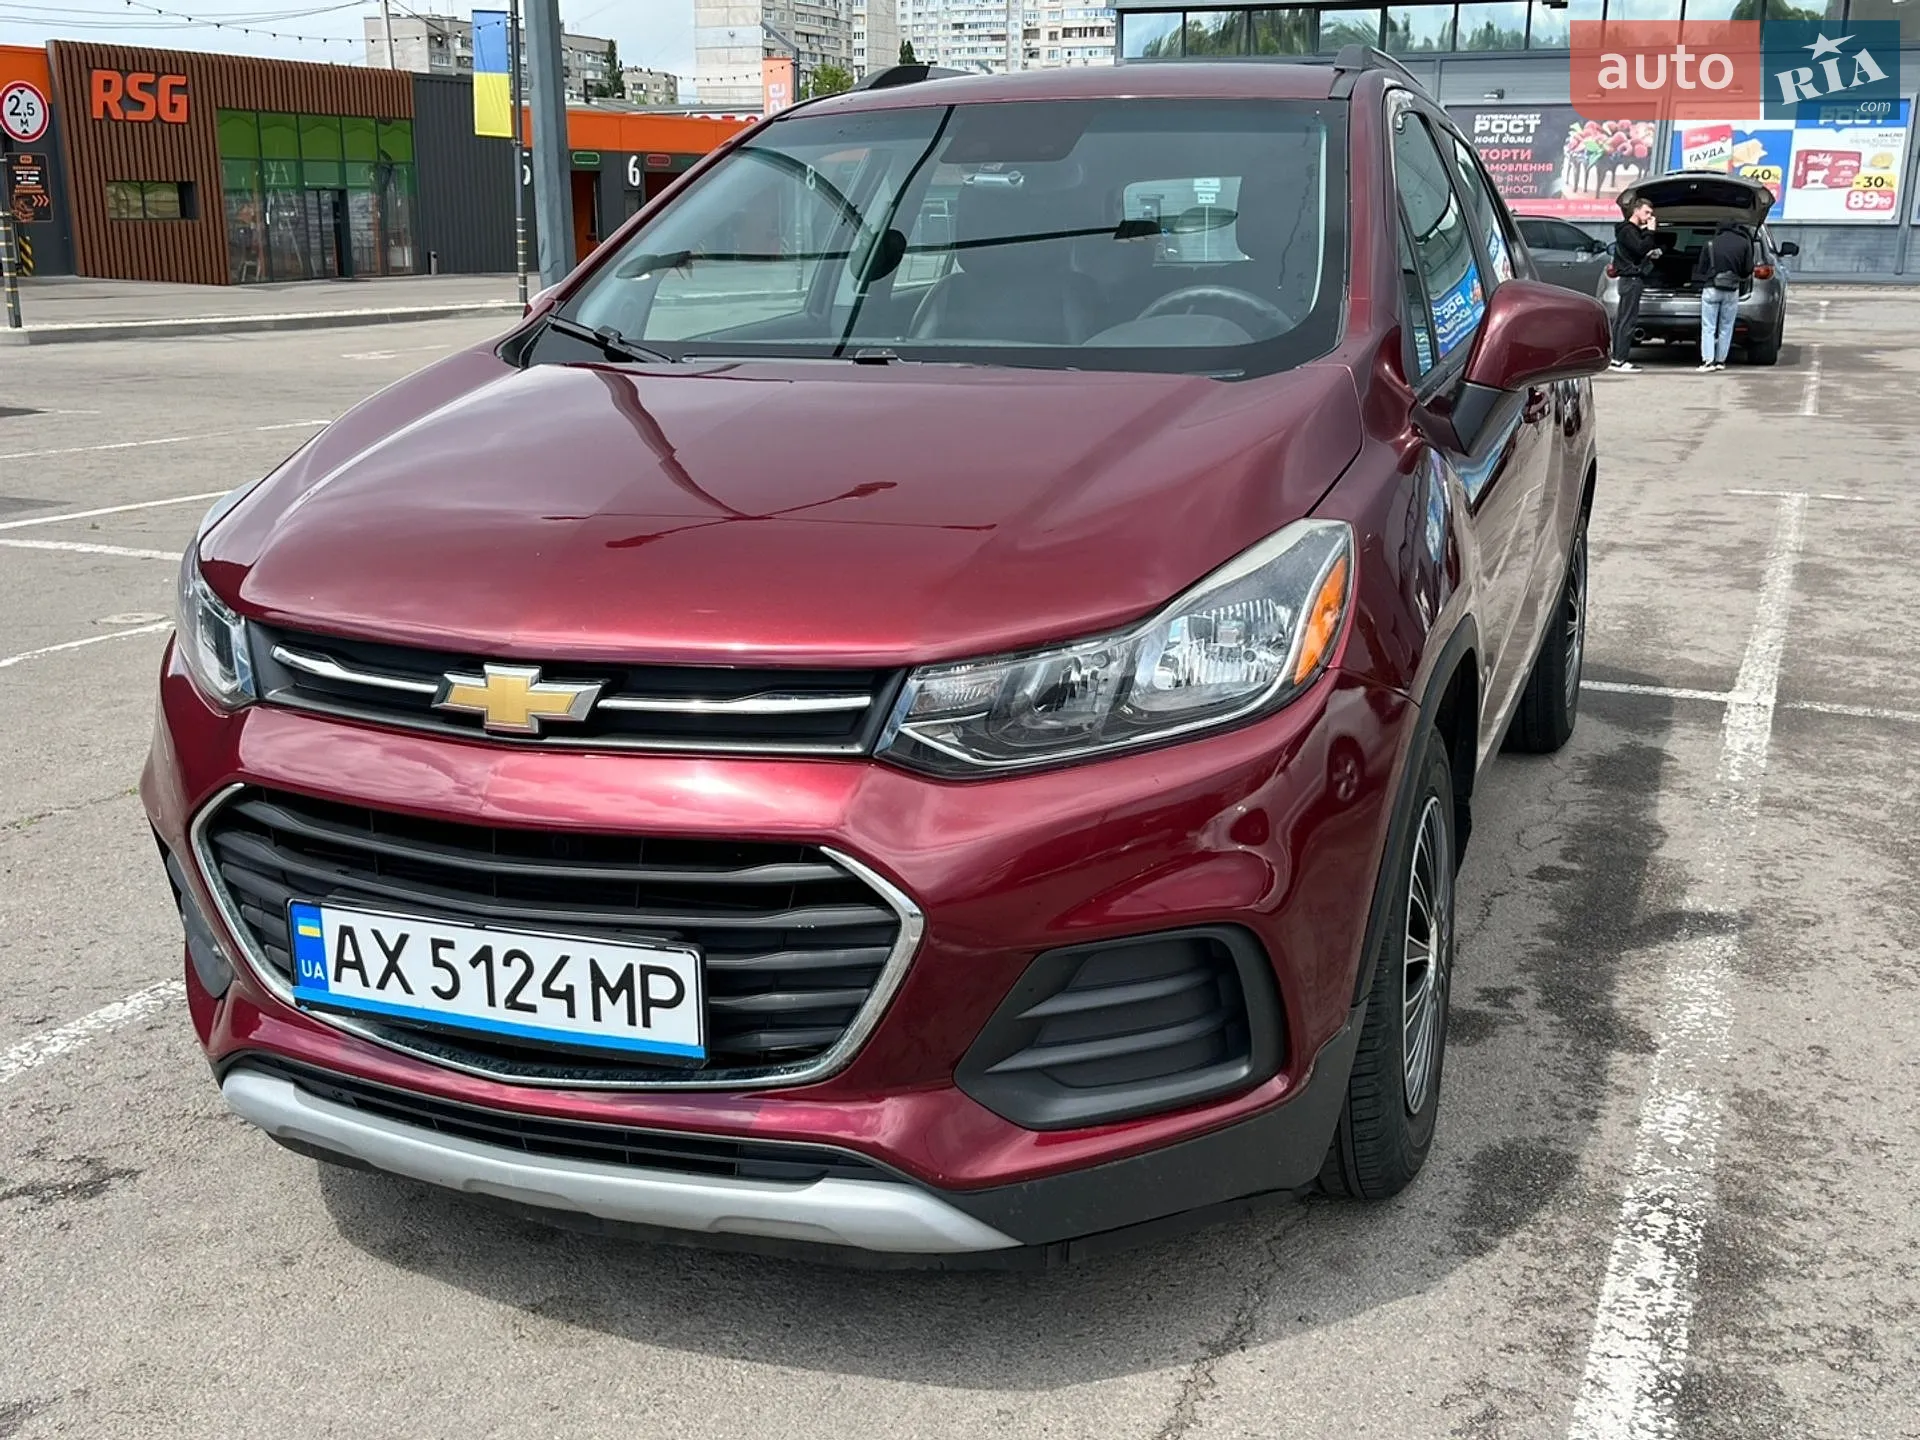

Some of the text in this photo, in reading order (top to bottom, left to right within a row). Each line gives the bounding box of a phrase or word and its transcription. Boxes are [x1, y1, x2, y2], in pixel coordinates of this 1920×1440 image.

[8, 95, 35, 117] 2,5
[92, 69, 188, 123] RSG
[20, 119, 29, 127] М
[1474, 119, 1541, 133] РОСТ
[1480, 149, 1532, 160] ТОРТИ
[1689, 146, 1725, 163] ГАУДА
[628, 155, 641, 187] 6
[806, 164, 816, 190] 8
[301, 959, 326, 981] UA
[333, 924, 686, 1029] AX 5124 MP
